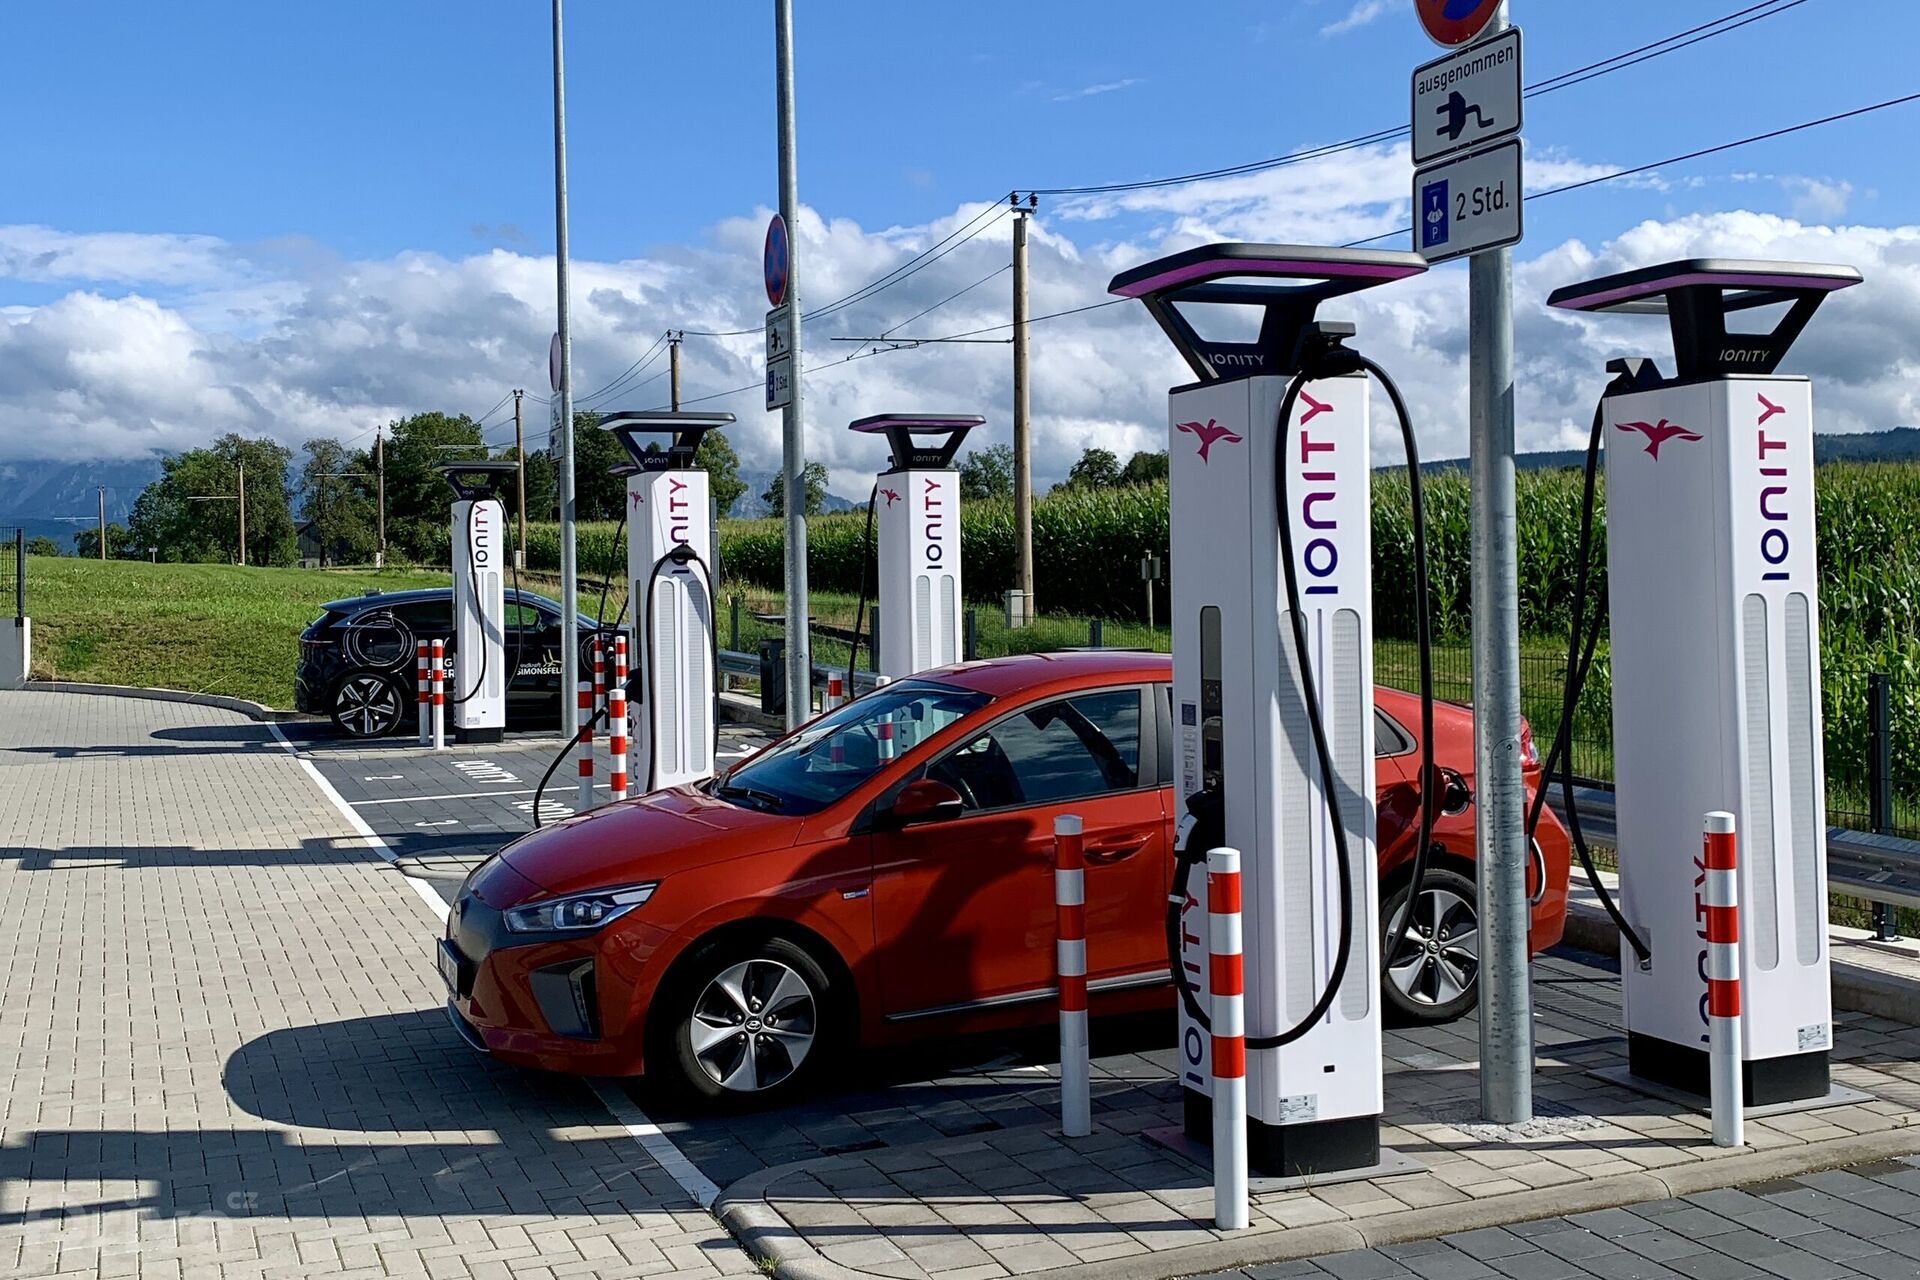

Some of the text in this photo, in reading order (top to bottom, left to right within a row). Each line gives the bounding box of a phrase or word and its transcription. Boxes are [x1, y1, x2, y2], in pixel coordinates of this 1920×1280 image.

[1418, 45, 1513, 95] ausgenommen
[1456, 180, 1509, 221] 2 Std.
[1432, 226, 1438, 240] P
[1209, 353, 1265, 367] IONITY
[1718, 349, 1770, 362] IONITY
[912, 454, 942, 462] IONITY
[1300, 389, 1339, 595] IONITY
[1757, 392, 1790, 581] IONITY
[475, 504, 488, 569] IONITY
[925, 478, 943, 570] IONITY
